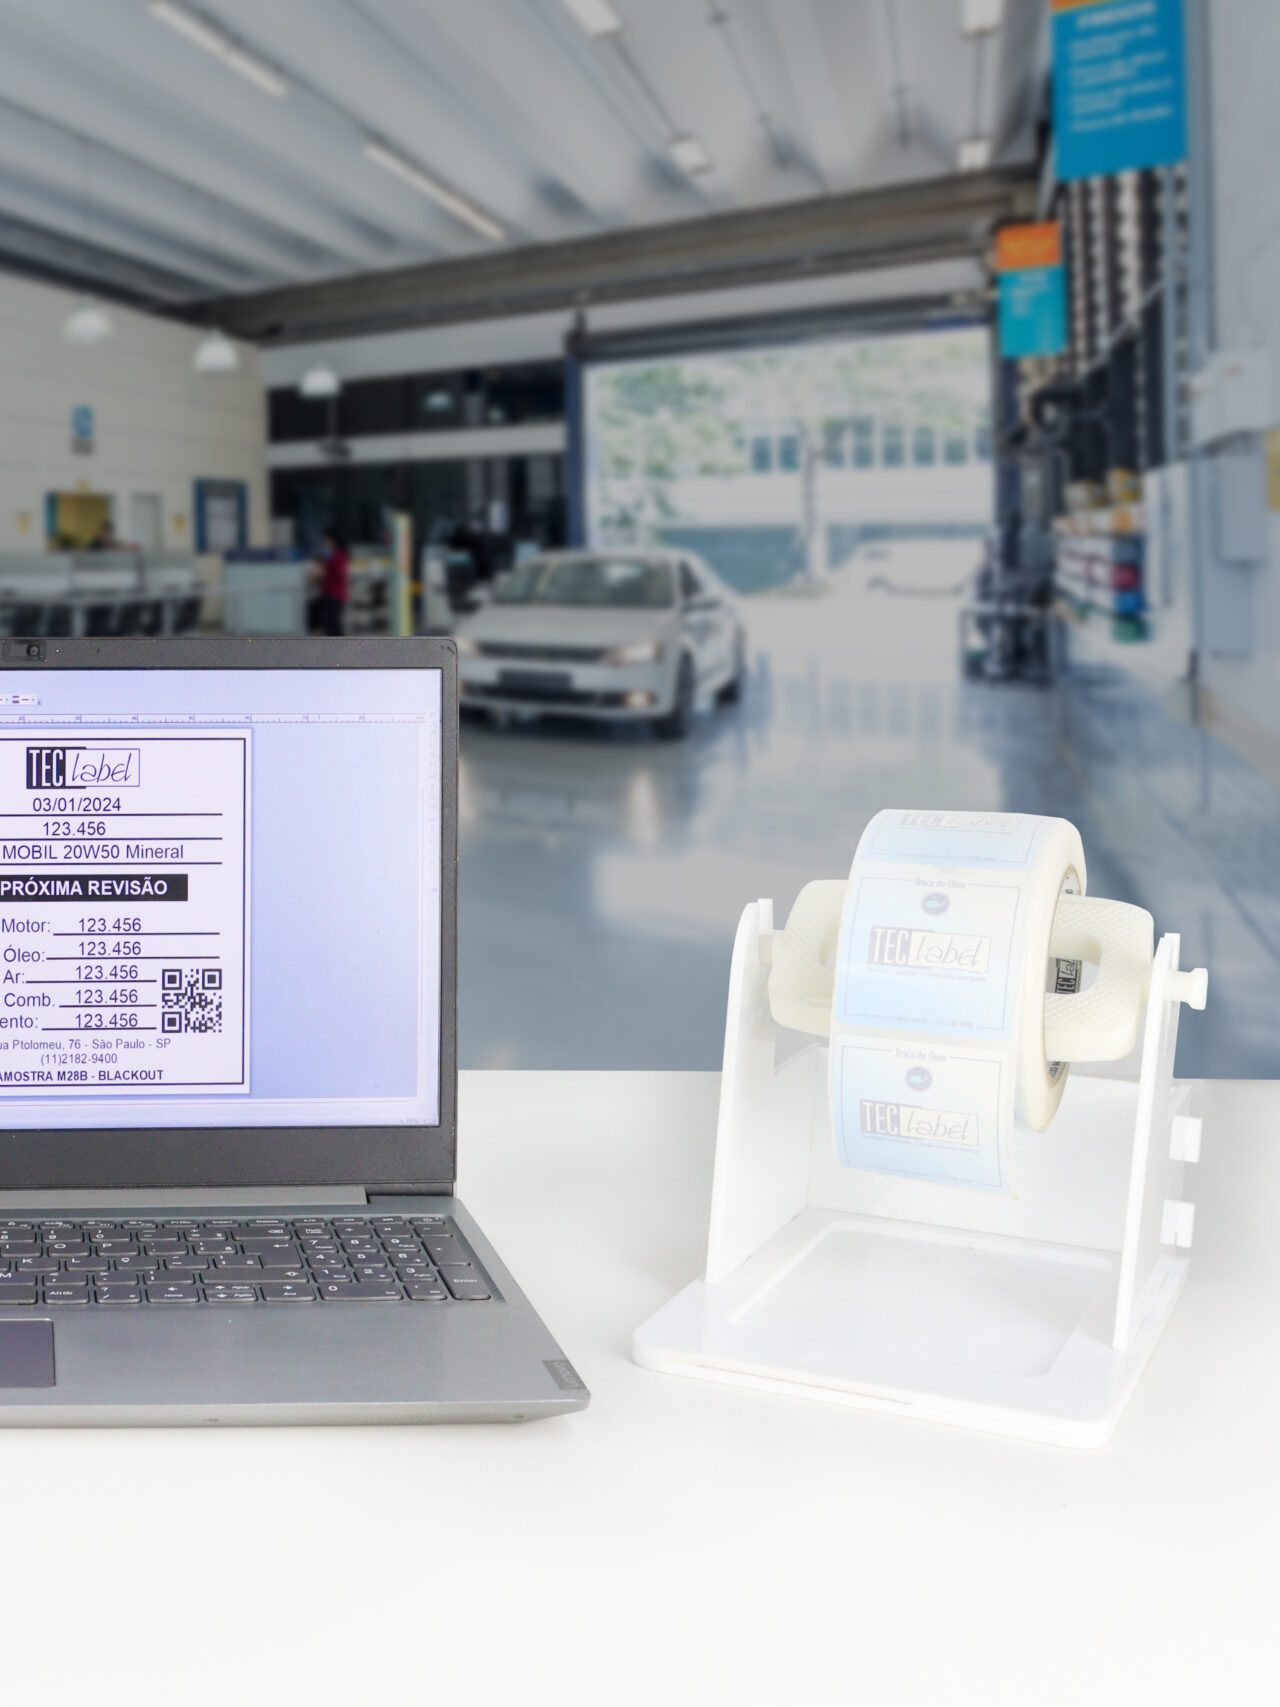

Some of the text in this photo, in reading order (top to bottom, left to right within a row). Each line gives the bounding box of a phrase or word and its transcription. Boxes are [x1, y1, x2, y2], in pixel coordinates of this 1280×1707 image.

[29, 749, 132, 787] TEC label
[32, 797, 121, 812] 03/01/2024
[42, 821, 106, 836] 123.456
[2, 845, 58, 860] MOBIL
[64, 845, 120, 859] 20W50
[126, 844, 184, 859] Mineral
[0, 876, 168, 896] PRÓXIMA REVISÃO
[1, 918, 51, 933] Motor:
[78, 918, 142, 932] 123.456
[3, 945, 45, 962] Óleo:
[78, 941, 142, 956] 123.456
[873, 928, 983, 967] TEC label
[3, 970, 25, 984] Ar:
[75, 965, 138, 980] 123.456
[3, 992, 55, 1007] Comb.
[75, 989, 138, 1004] 123.456
[75, 1013, 138, 1028] 123.456
[12, 1039, 65, 1052] Ptolomeu,
[68, 1039, 81, 1050] 76
[92, 1038, 112, 1050] São
[116, 1038, 145, 1050] Paulo
[156, 1038, 171, 1049] SP
[40, 1053, 117, 1066] (11)2182-9400
[57, 1070, 88, 1081] M28B
[98, 1069, 164, 1081] BLACKOUT
[863, 1101, 971, 1140] TEC label
